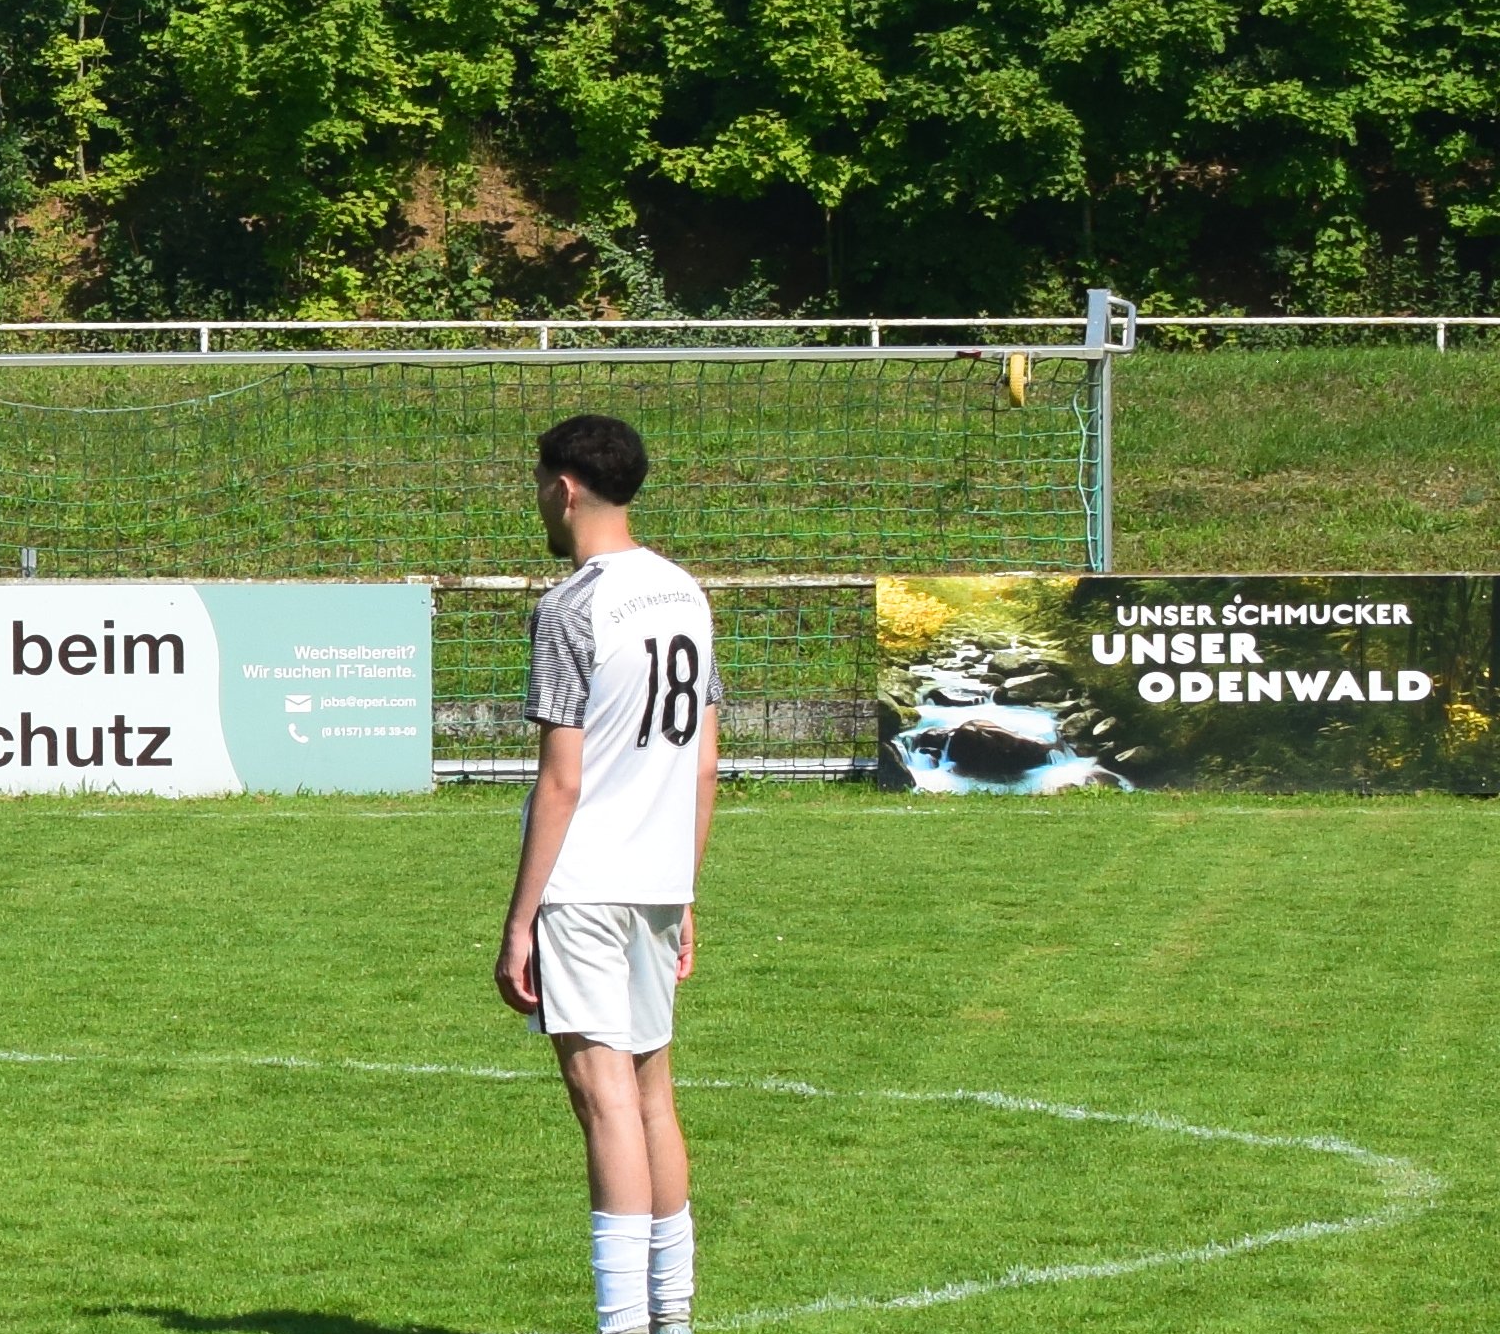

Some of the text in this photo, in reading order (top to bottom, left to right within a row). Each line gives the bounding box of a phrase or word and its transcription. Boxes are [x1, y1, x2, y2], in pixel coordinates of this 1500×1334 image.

[1116, 603, 1413, 626] UNSER SCHMUCKER
[11, 620, 185, 676] beim
[293, 645, 416, 660] Wechselbereit?
[1091, 633, 1264, 665] UNSER
[243, 664, 416, 679] Wir suchen IT-Talente.
[1137, 670, 1432, 703] ODENWALD
[636, 634, 699, 749] 18
